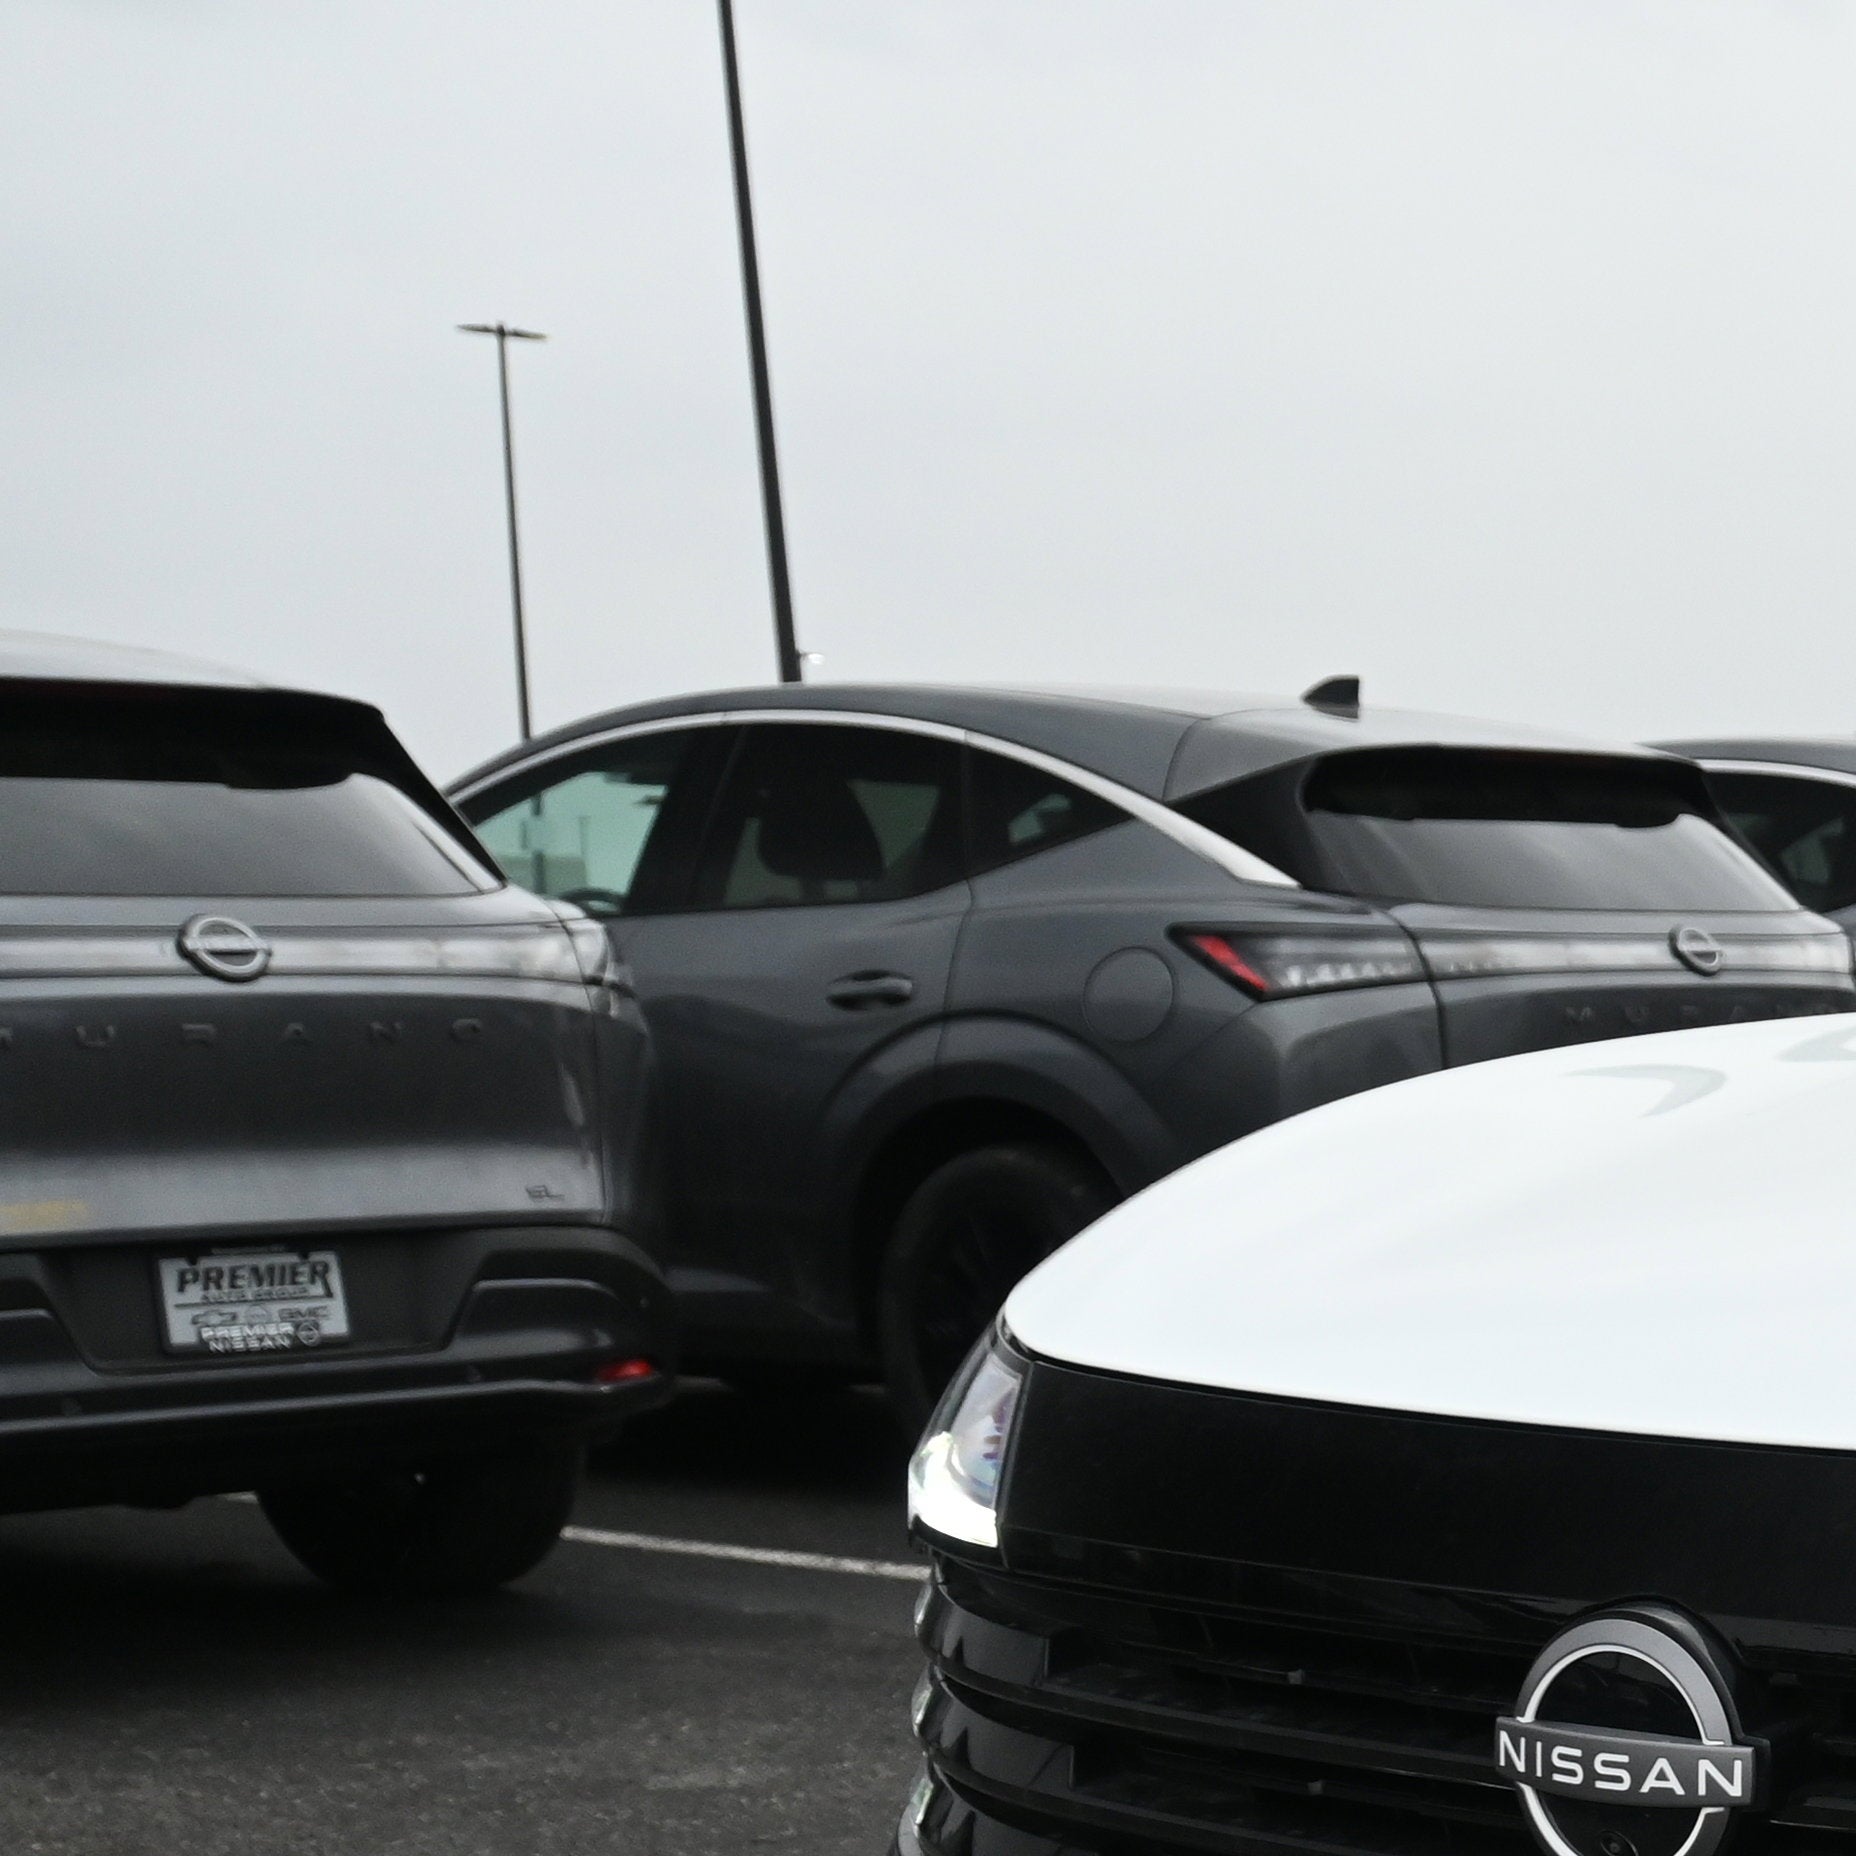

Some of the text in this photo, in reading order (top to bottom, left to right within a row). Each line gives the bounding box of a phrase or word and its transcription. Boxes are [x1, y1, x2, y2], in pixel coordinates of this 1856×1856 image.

[0, 1017, 483, 1049] URANO
[176, 1260, 333, 1298] PREMIER
[200, 1322, 295, 1340] PREMIER
[208, 1335, 294, 1353] NISSAN
[1499, 1730, 1743, 1797] NISSAN
